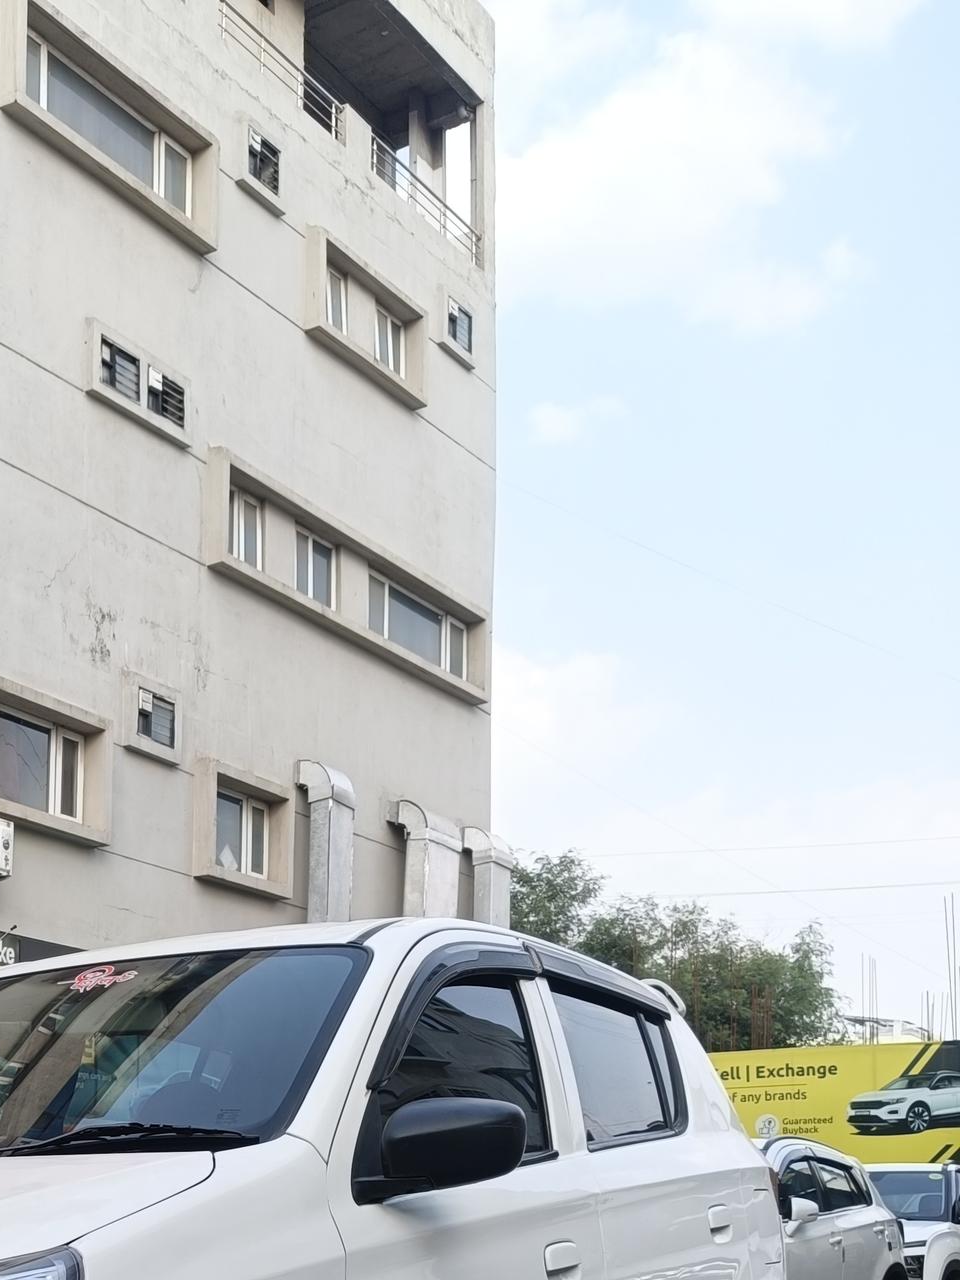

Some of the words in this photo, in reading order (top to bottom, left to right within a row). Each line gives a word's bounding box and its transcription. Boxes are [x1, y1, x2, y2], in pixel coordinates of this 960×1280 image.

[716, 1066, 741, 1080] ell
[756, 1063, 838, 1079] Exchange
[740, 1093, 761, 1104] any
[764, 1089, 807, 1102] brands
[782, 1116, 833, 1126] Guaranteed
[782, 1125, 820, 1136] Buyback
